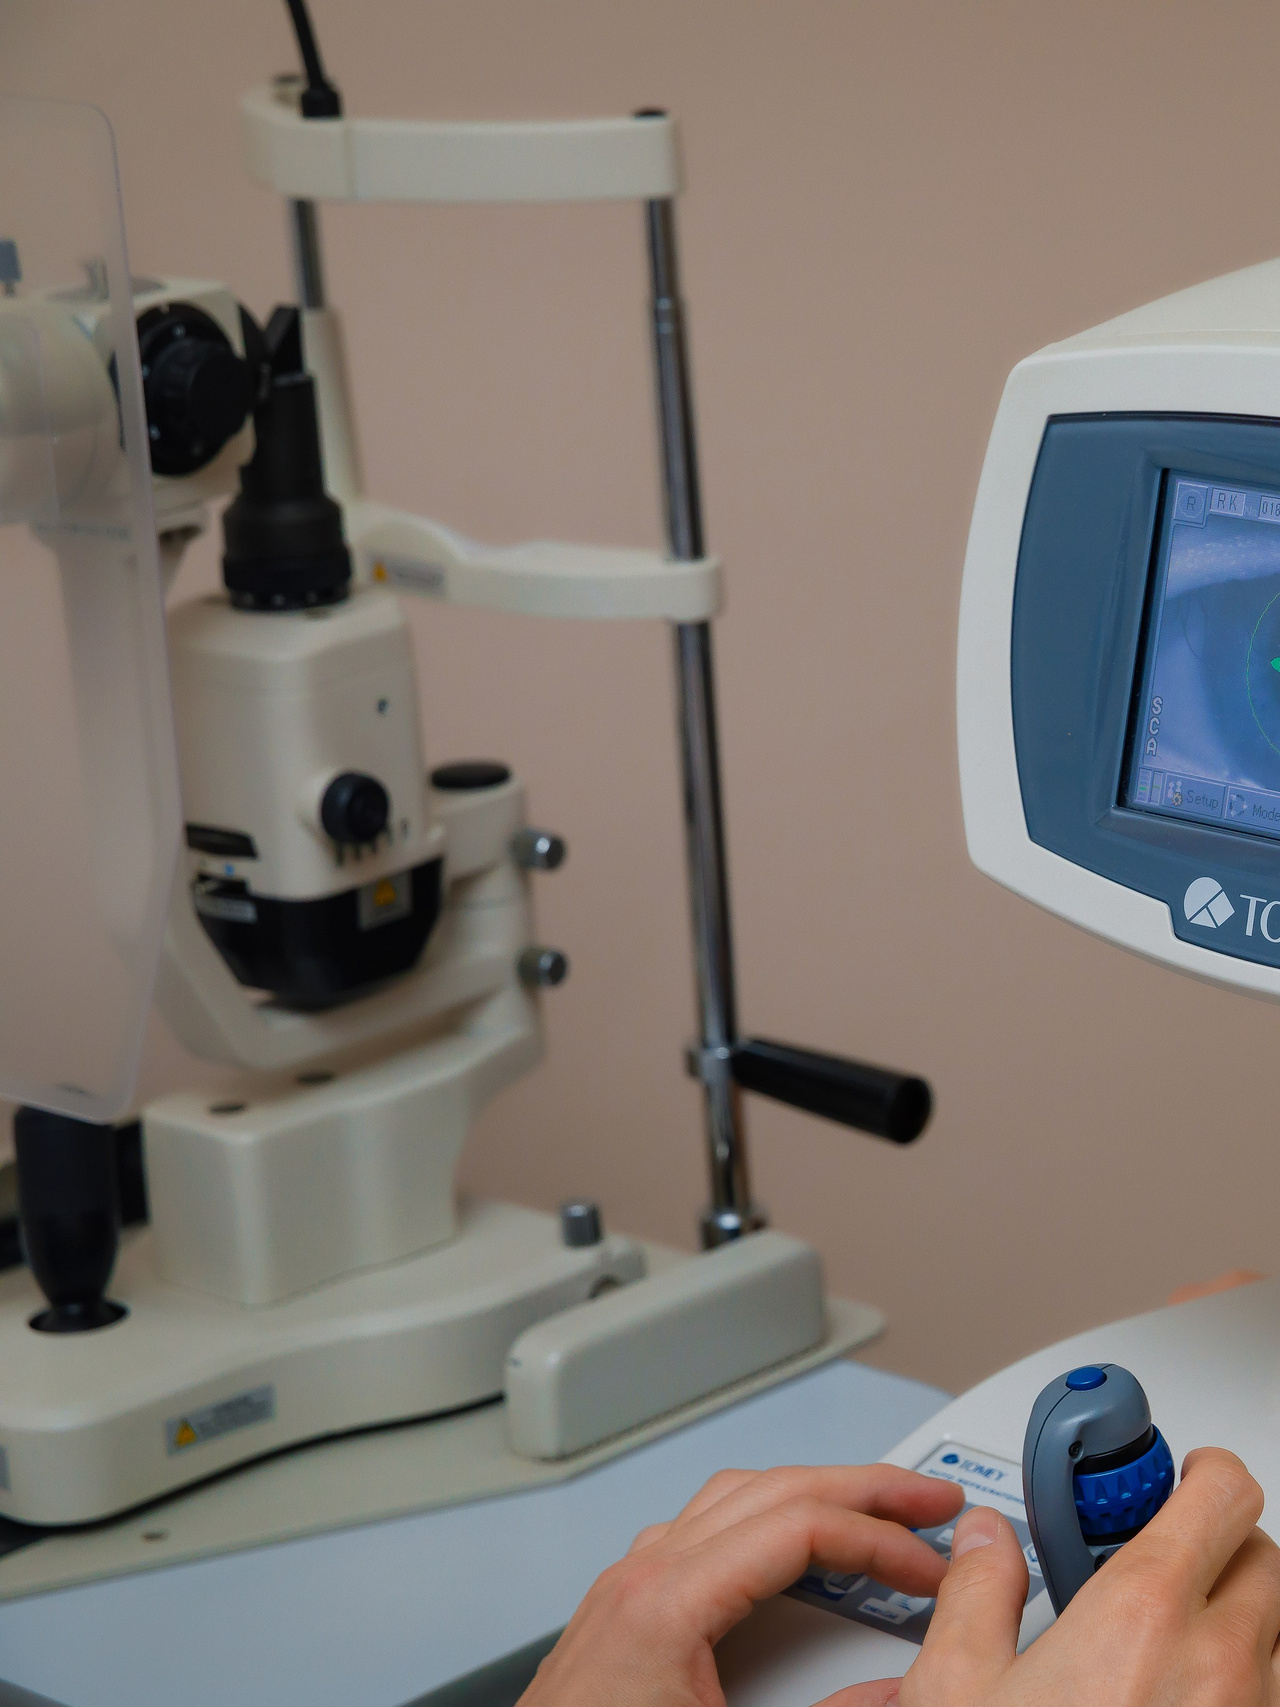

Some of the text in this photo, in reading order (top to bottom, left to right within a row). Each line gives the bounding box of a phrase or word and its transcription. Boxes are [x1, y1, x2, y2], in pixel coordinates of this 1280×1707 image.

[1217, 492, 1238, 511] RK
[1152, 696, 1163, 715] S
[1149, 716, 1160, 735] C
[1146, 737, 1157, 756] A
[1185, 789, 1219, 811] Setup
[1252, 803, 1280, 821] Mode
[959, 1459, 1006, 1481] TOMEY
